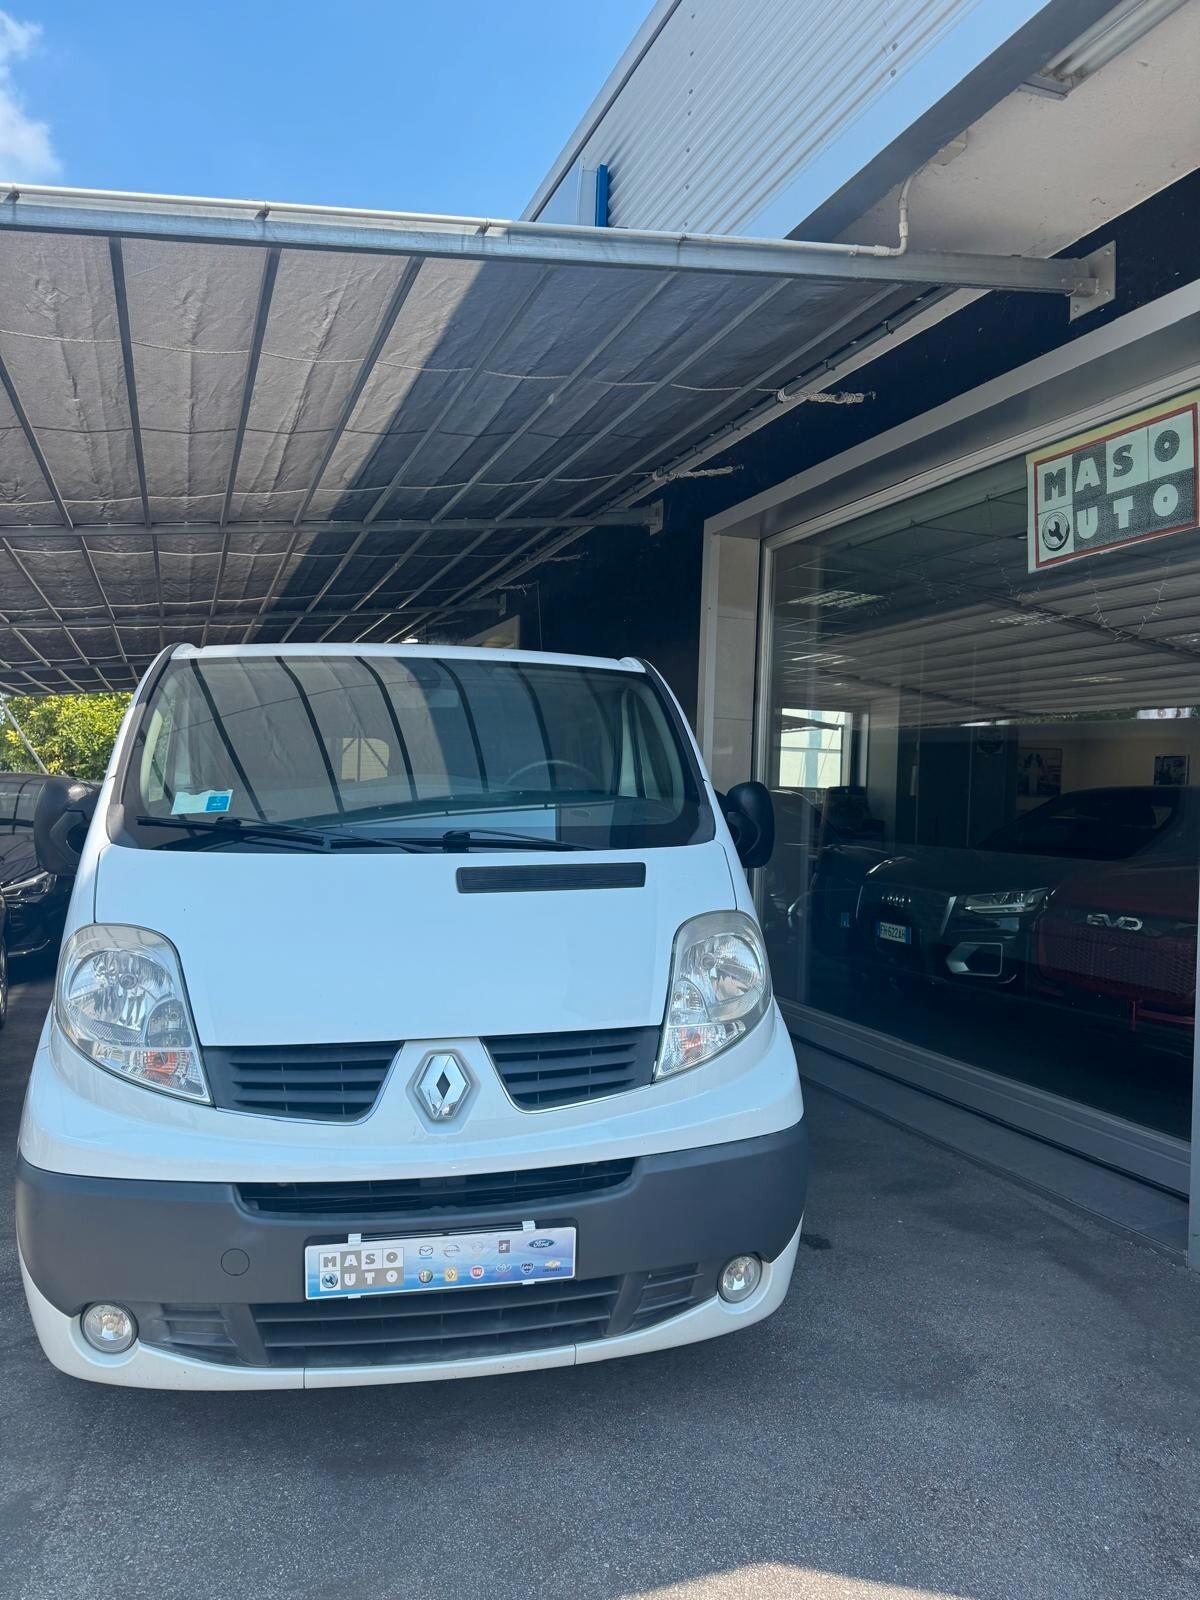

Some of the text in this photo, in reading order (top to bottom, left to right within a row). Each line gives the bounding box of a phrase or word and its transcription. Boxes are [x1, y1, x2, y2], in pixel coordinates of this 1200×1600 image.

[1044, 429, 1180, 502] MASO
[1077, 483, 1179, 539] UTO
[533, 1240, 550, 1248] Ford
[323, 1251, 398, 1268] MASO
[344, 1270, 398, 1286] UTO
